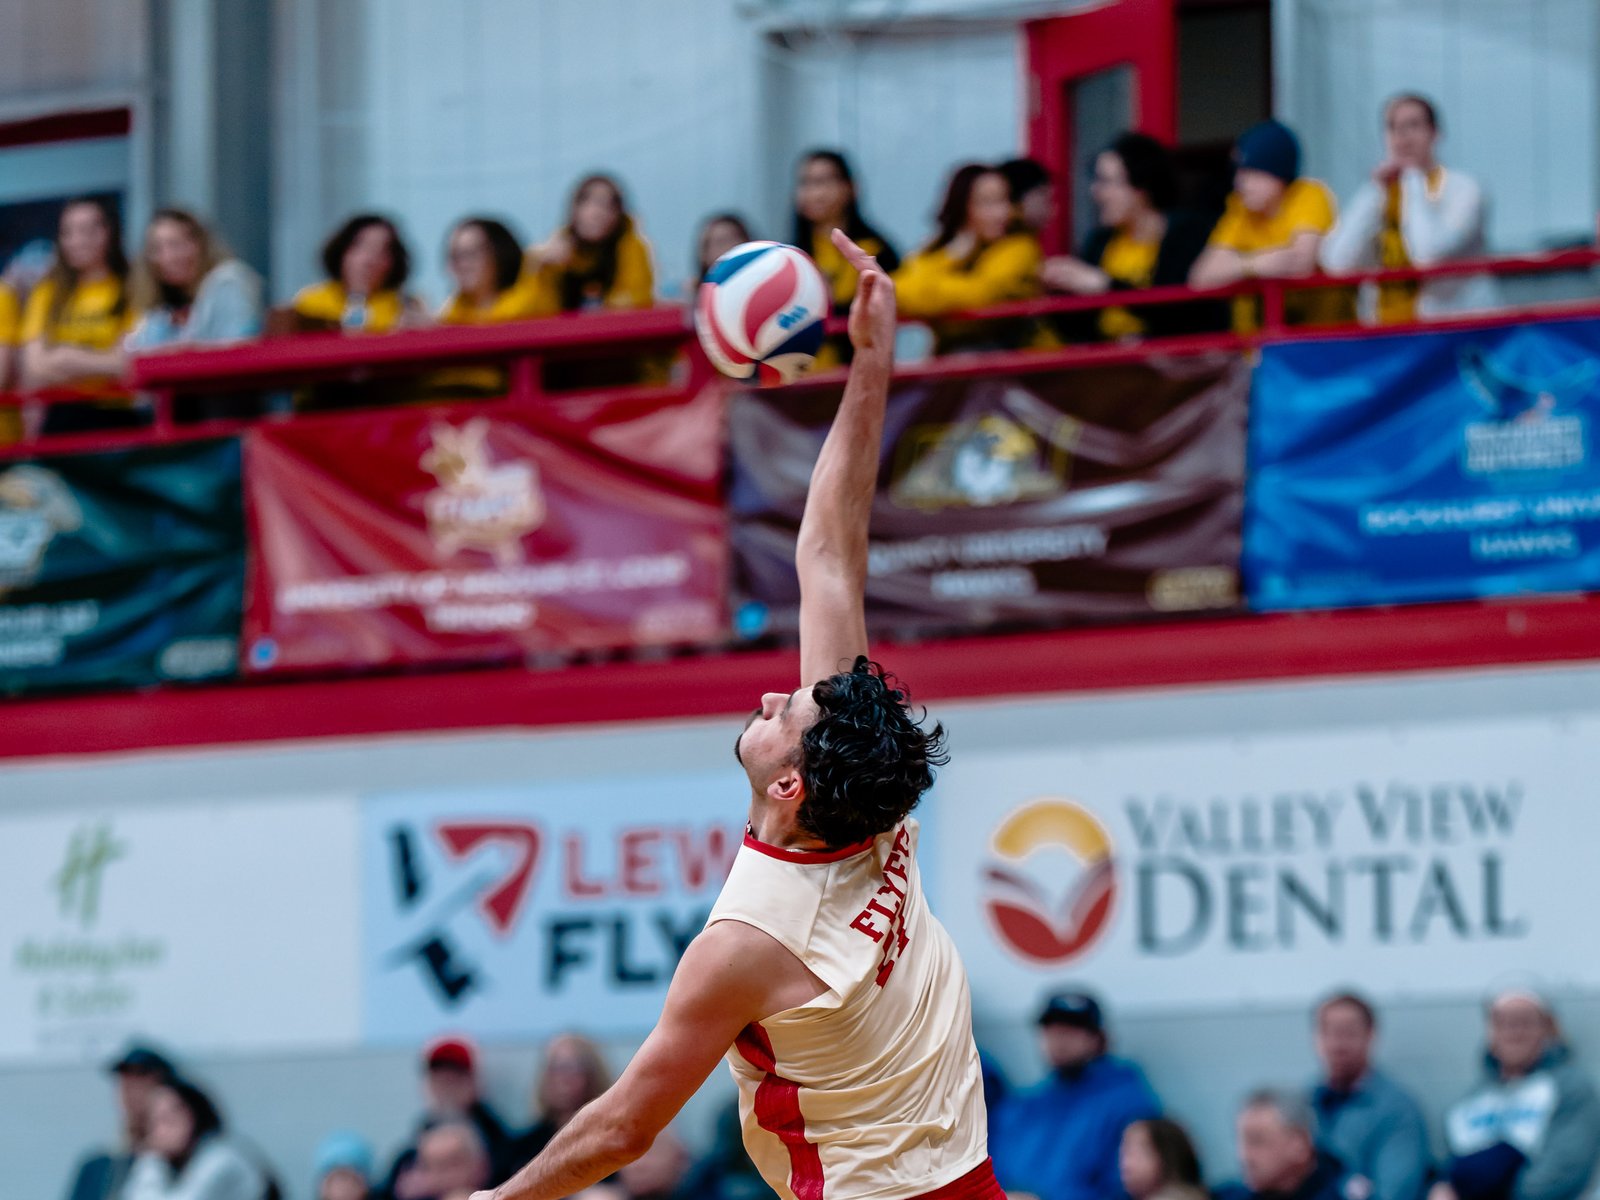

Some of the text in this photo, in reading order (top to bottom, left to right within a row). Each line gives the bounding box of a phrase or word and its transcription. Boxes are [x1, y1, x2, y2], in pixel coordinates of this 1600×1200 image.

[1124, 781, 1523, 855] VALLEY VIEW
[566, 826, 740, 896] LEW
[1137, 849, 1531, 957] DENTAL
[547, 912, 707, 992] FLY
